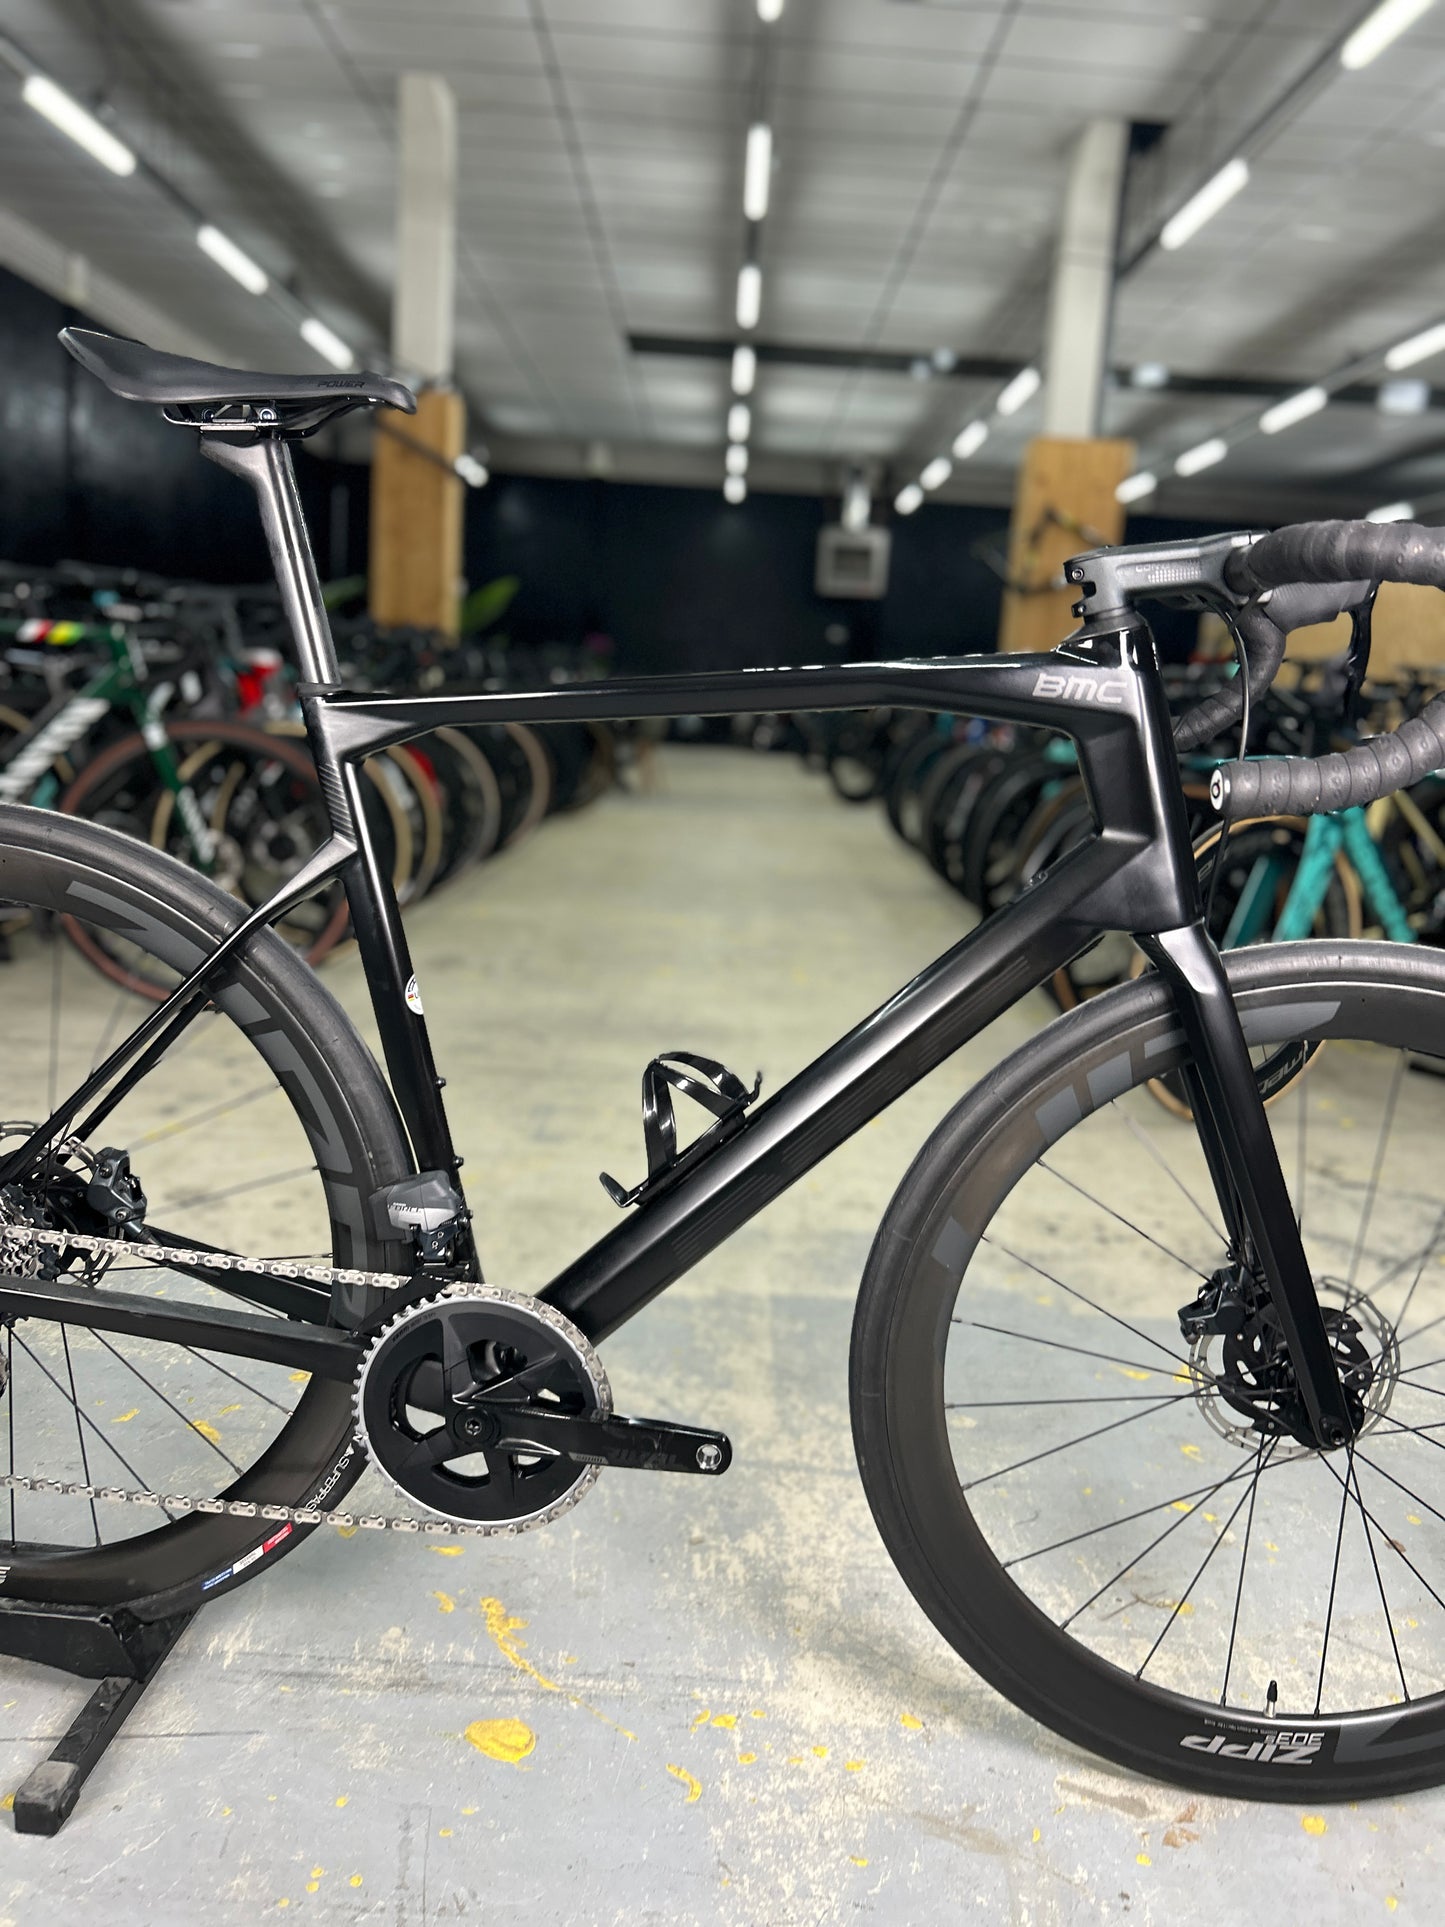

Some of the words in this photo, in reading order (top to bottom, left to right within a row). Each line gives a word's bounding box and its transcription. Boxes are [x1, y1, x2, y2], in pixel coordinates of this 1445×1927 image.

[317, 380, 366, 389] POWER
[1031, 672, 1128, 704] BMC
[304, 1455, 350, 1513] SUPERPAS
[1179, 1734, 1322, 1765] ZIPP
